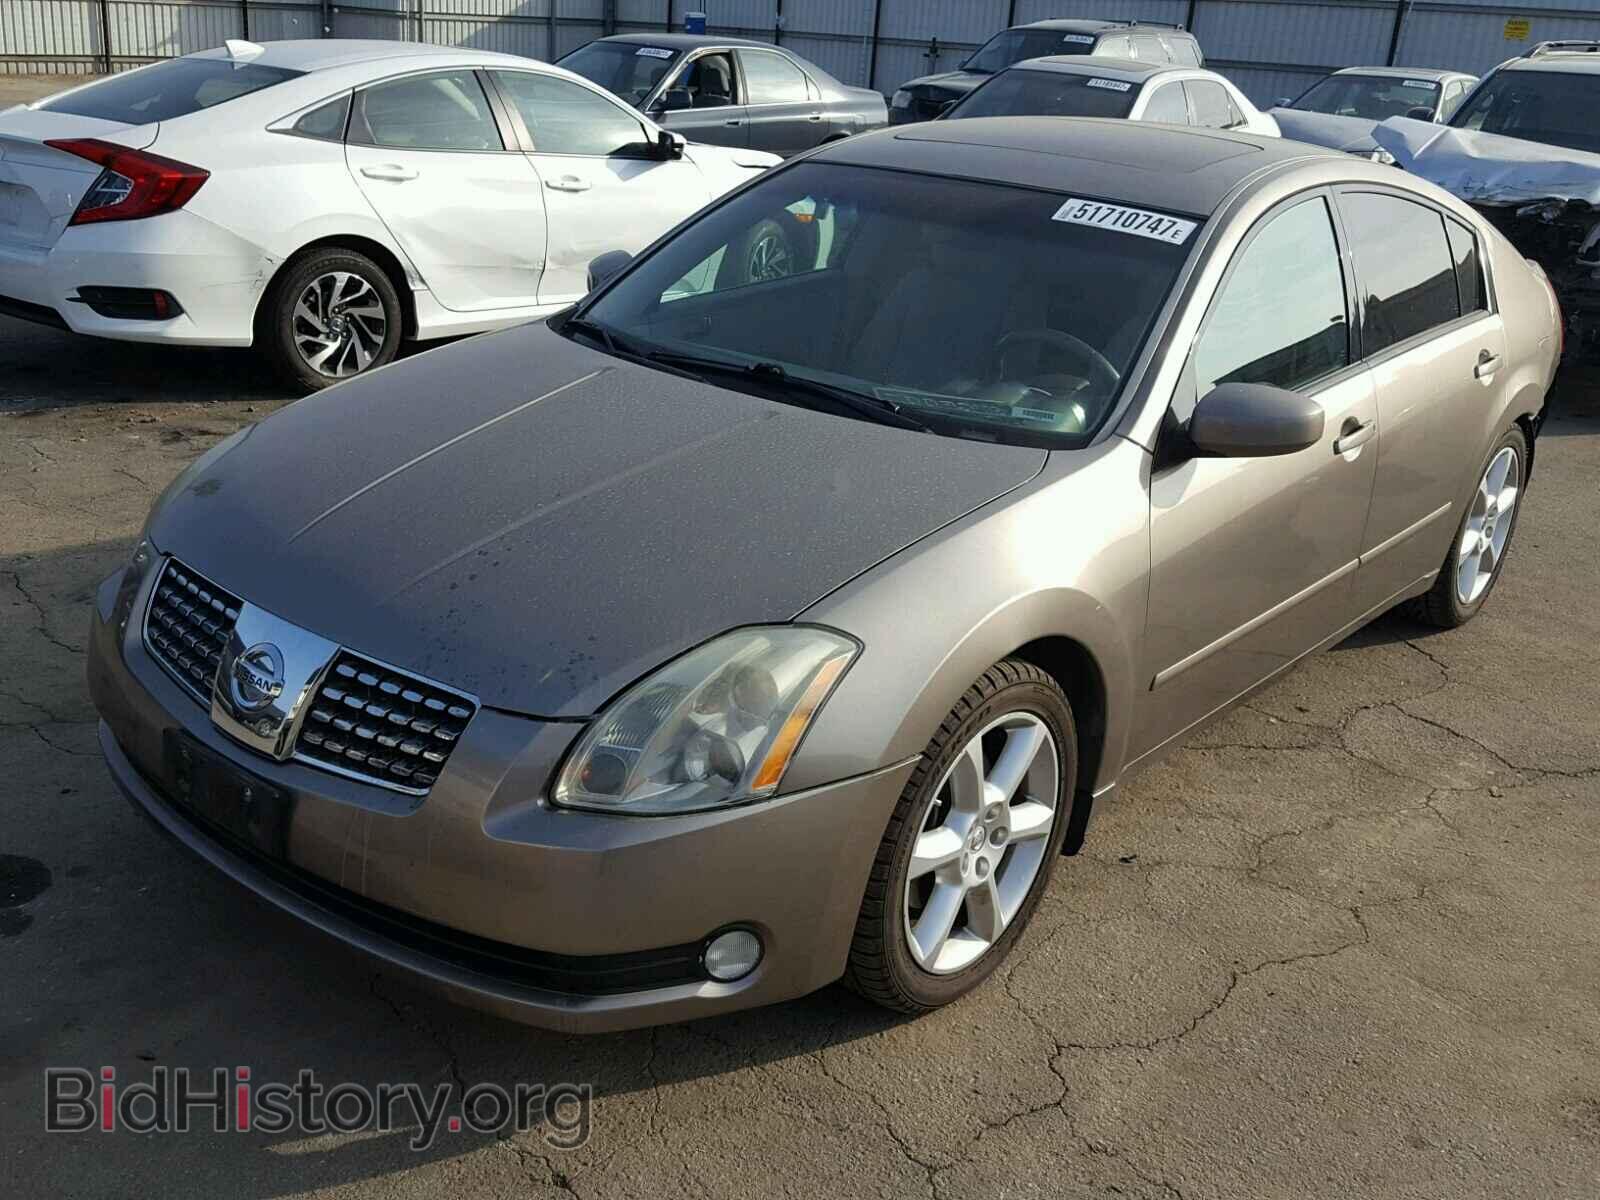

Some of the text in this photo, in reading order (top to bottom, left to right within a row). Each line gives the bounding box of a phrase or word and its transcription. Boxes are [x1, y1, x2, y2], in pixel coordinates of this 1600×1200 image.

[1073, 203, 1178, 236] 51710747
[1171, 229, 1183, 239] E
[235, 665, 274, 692] SSAN
